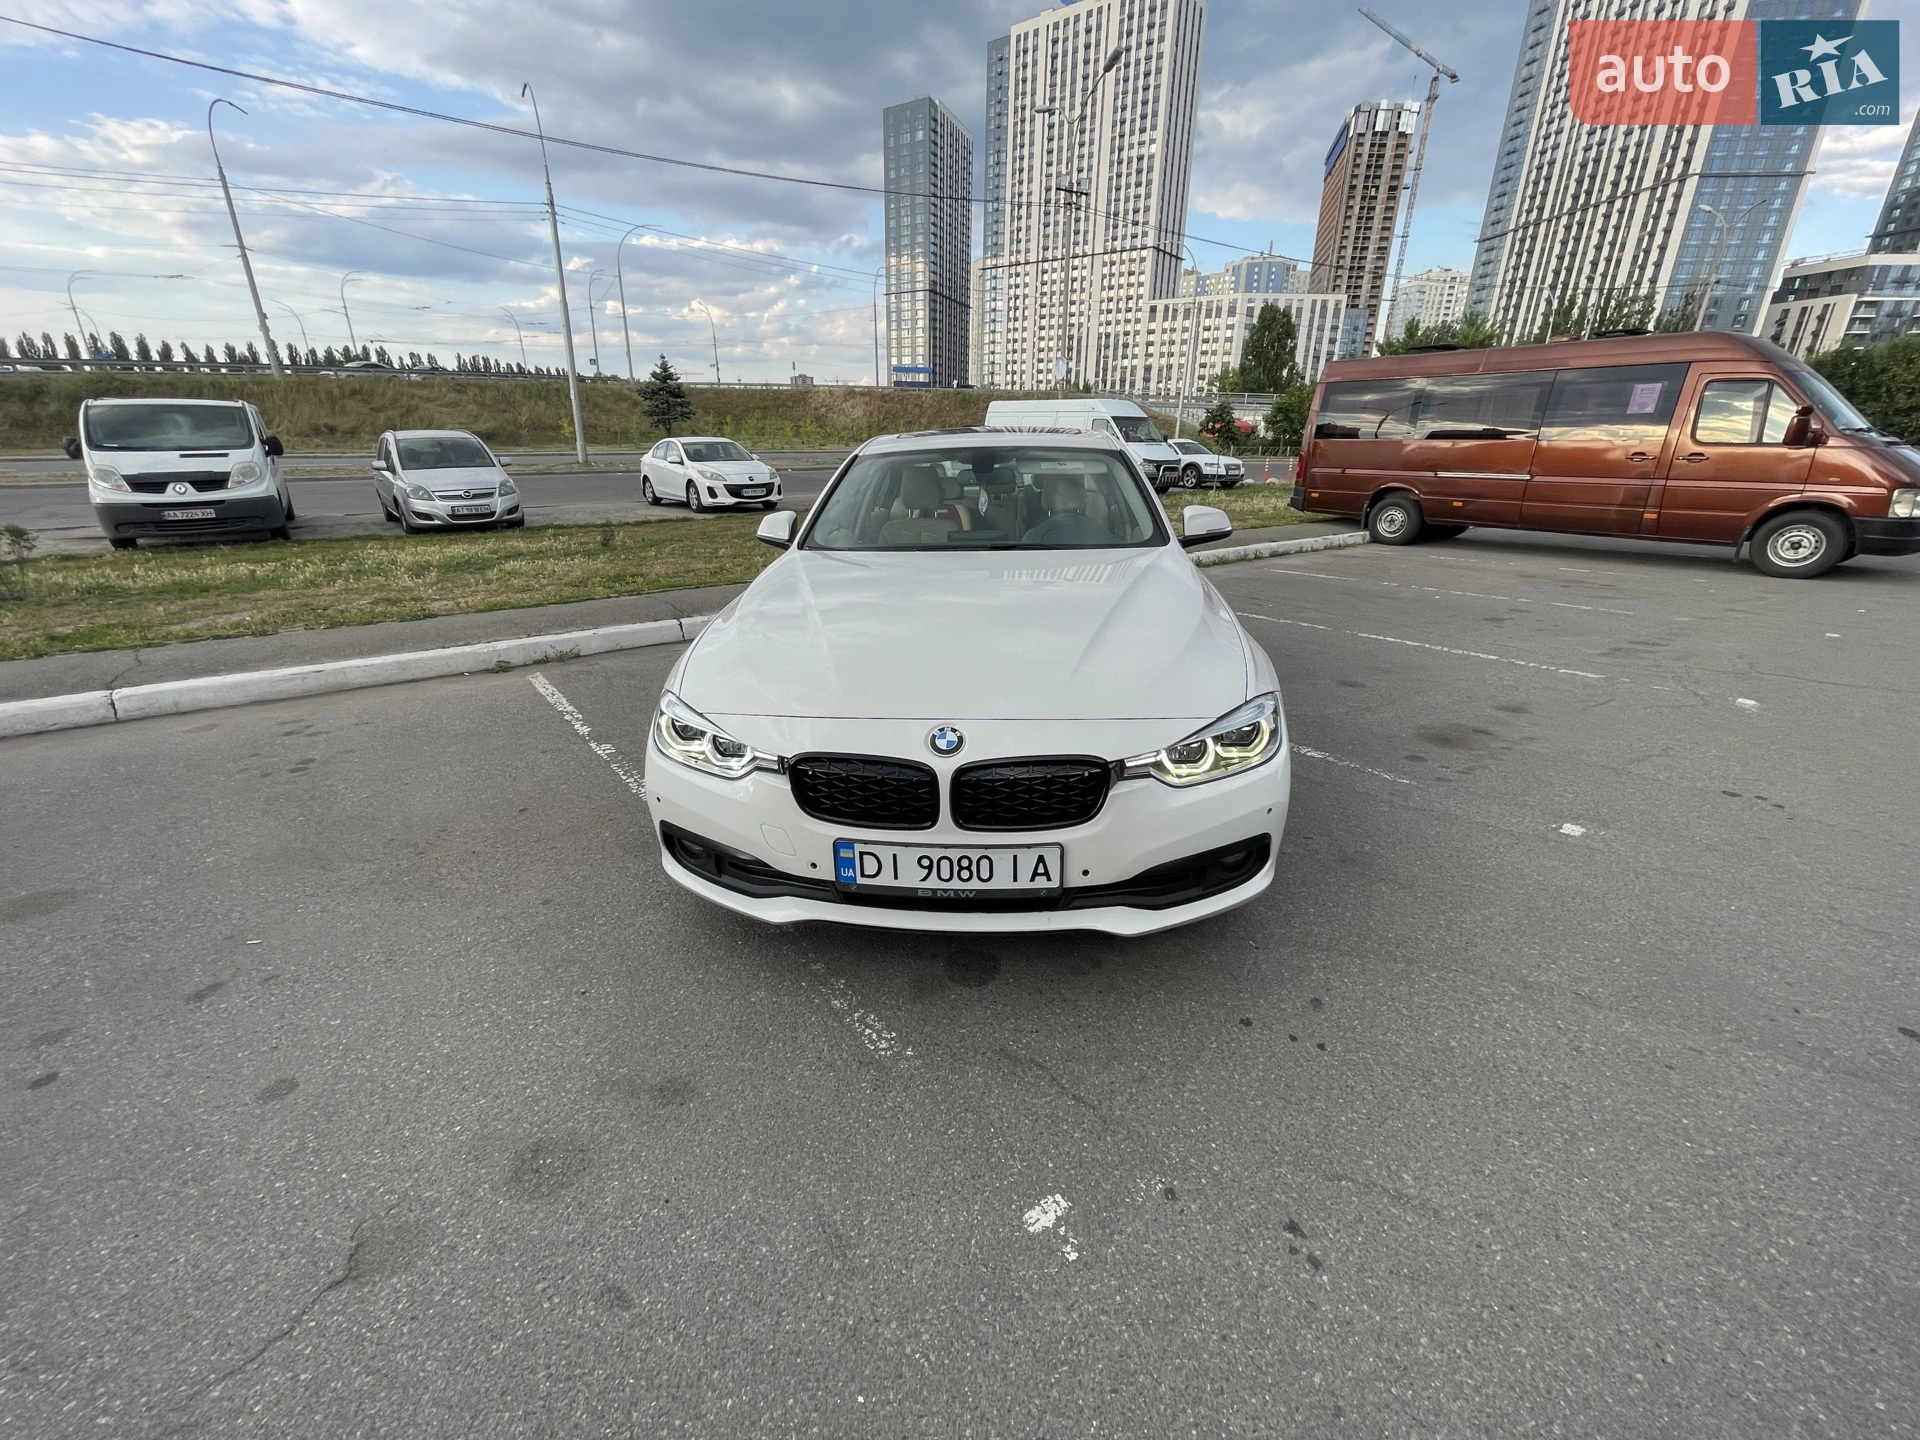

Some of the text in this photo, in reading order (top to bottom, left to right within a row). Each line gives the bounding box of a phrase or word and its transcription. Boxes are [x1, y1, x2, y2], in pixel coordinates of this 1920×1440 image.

[858, 851, 1053, 883] DI 9080 IA
[840, 868, 855, 878] UA
[917, 889, 977, 898] BMW
